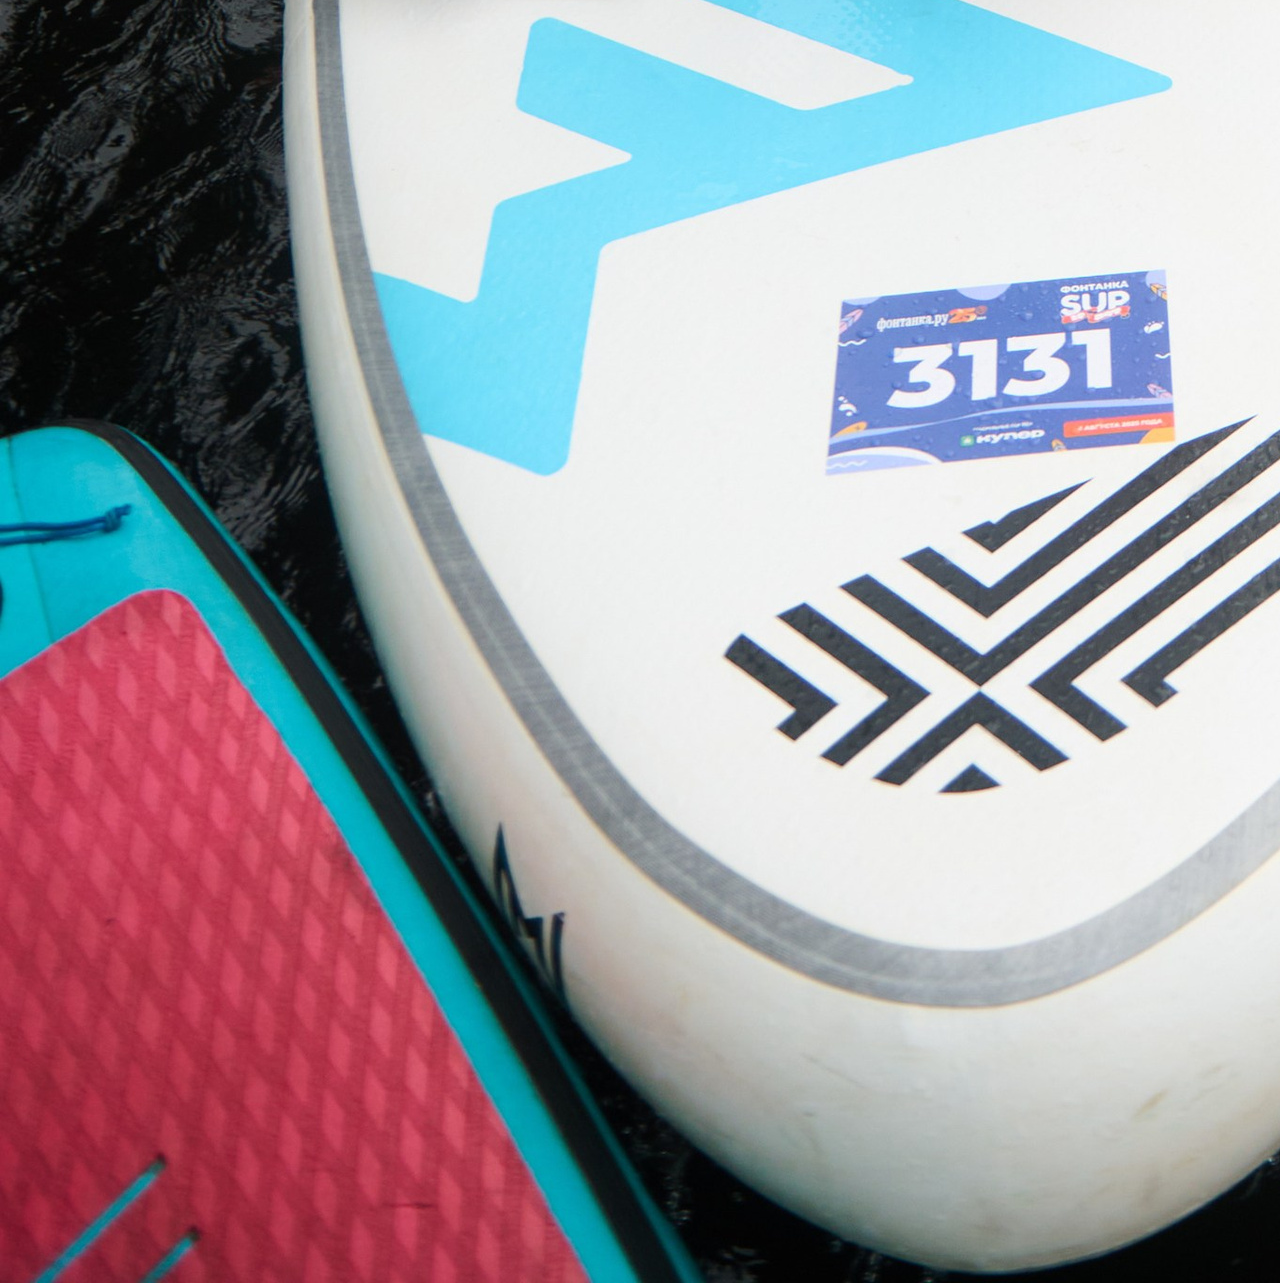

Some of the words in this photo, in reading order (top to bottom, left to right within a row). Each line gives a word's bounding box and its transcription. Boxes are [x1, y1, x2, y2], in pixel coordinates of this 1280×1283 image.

[1059, 280, 1130, 294] ФОНТАНКА
[1060, 290, 1131, 317] SUP
[876, 313, 949, 333] фонтанка.ру
[886, 328, 1112, 408] 3131
